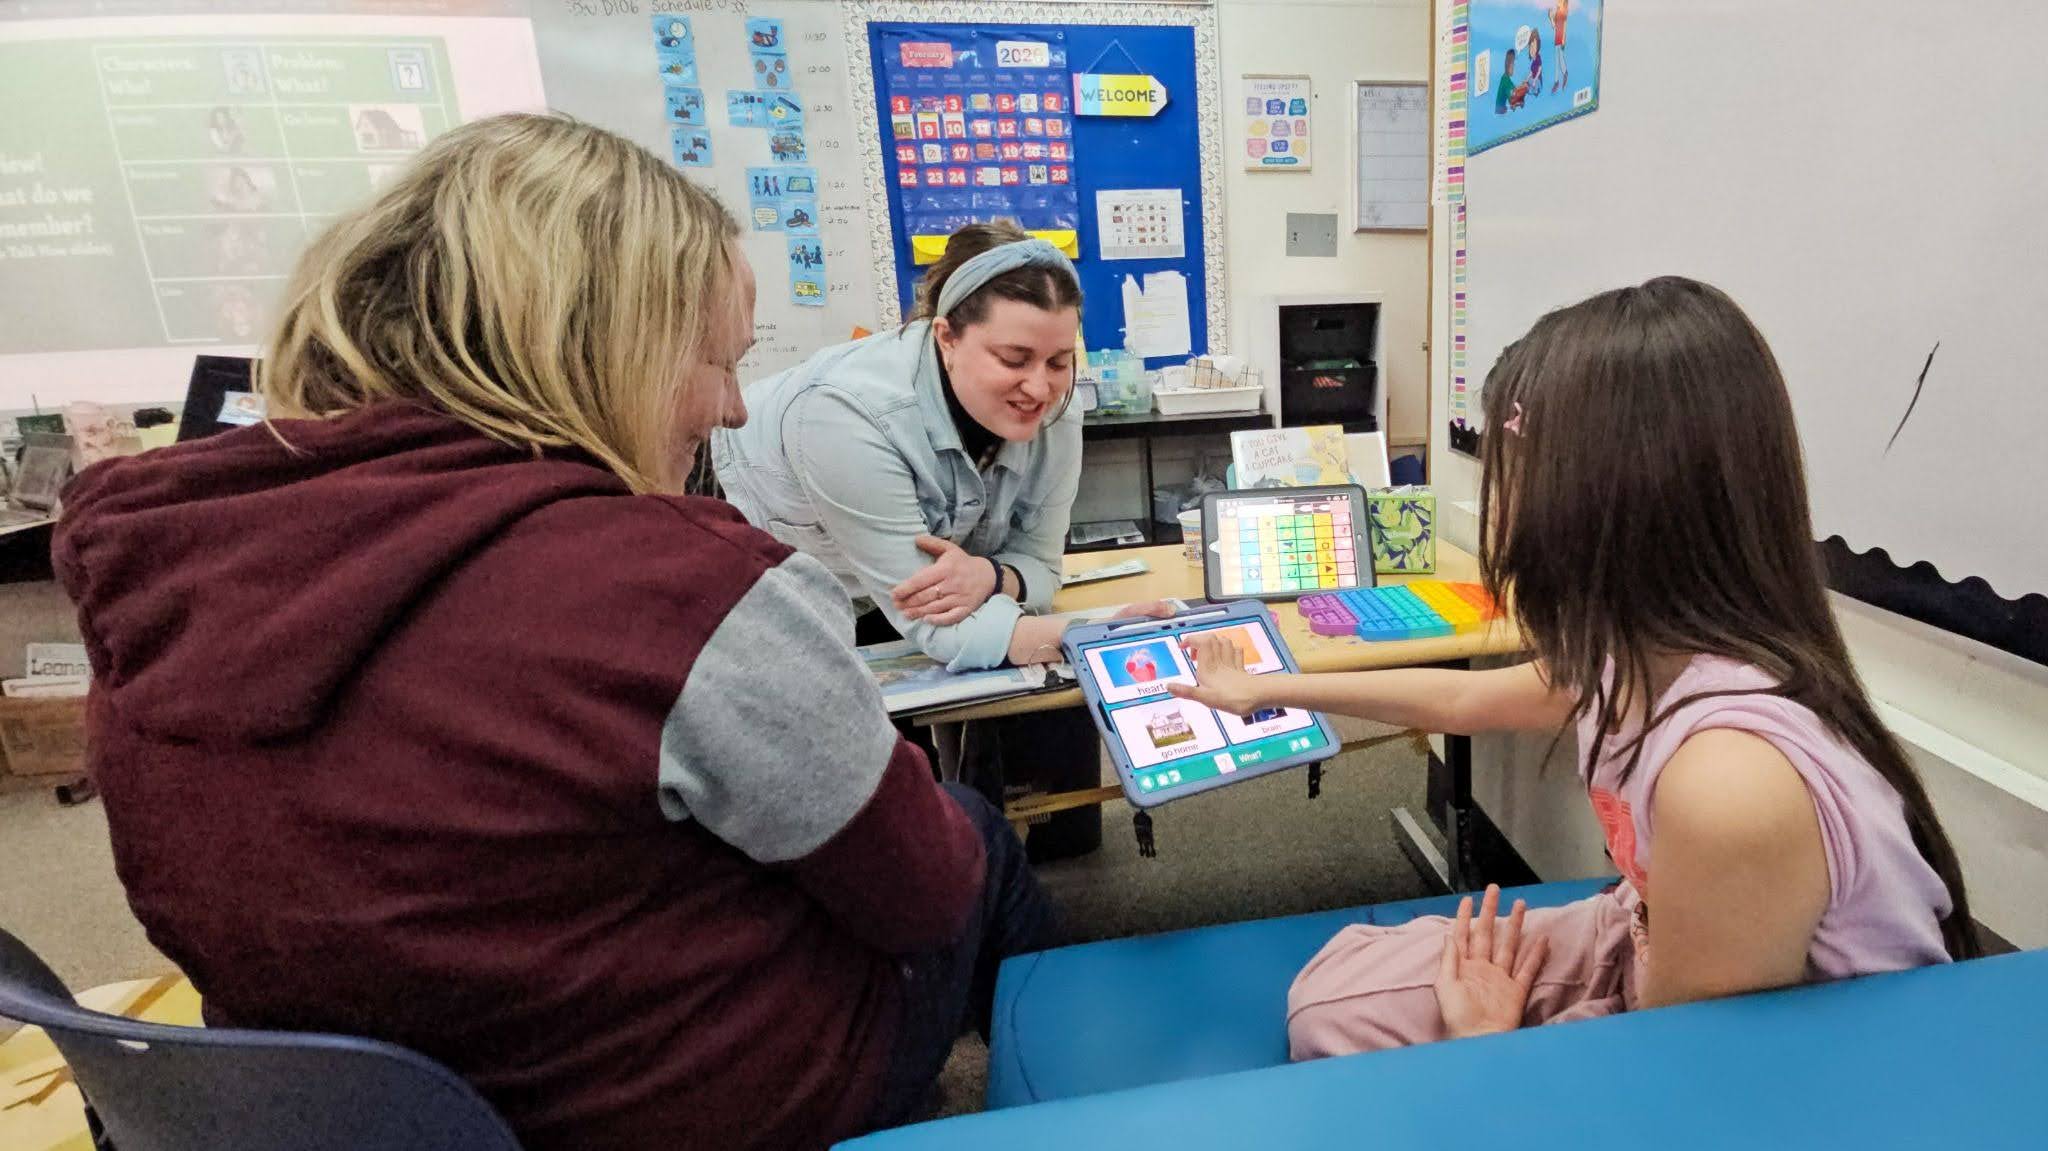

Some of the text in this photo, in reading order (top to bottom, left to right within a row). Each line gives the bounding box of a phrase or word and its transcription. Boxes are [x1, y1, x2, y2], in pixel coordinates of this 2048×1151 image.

[1080, 88, 1157, 103] WELCOME
[950, 99, 959, 111] 3
[1001, 97, 1010, 109] 5
[924, 126, 934, 136] 9
[947, 123, 962, 135] 10
[999, 122, 1015, 134] 12
[898, 149, 915, 159] 15
[953, 147, 968, 159] 17
[1003, 146, 1018, 158] 19
[1050, 146, 1066, 157] 21
[899, 173, 917, 184] 22
[927, 172, 943, 184] 23
[949, 172, 966, 183] 24
[1002, 171, 1018, 182] 26
[1051, 170, 1067, 181] 28
[63, 188, 93, 204] we
[1261, 446, 1279, 457] CAT
[1252, 452, 1295, 471] CUPCAKE
[1137, 683, 1166, 696] heart
[1261, 723, 1282, 734] brain
[1161, 743, 1199, 760] go home
[1239, 749, 1262, 763] What?
